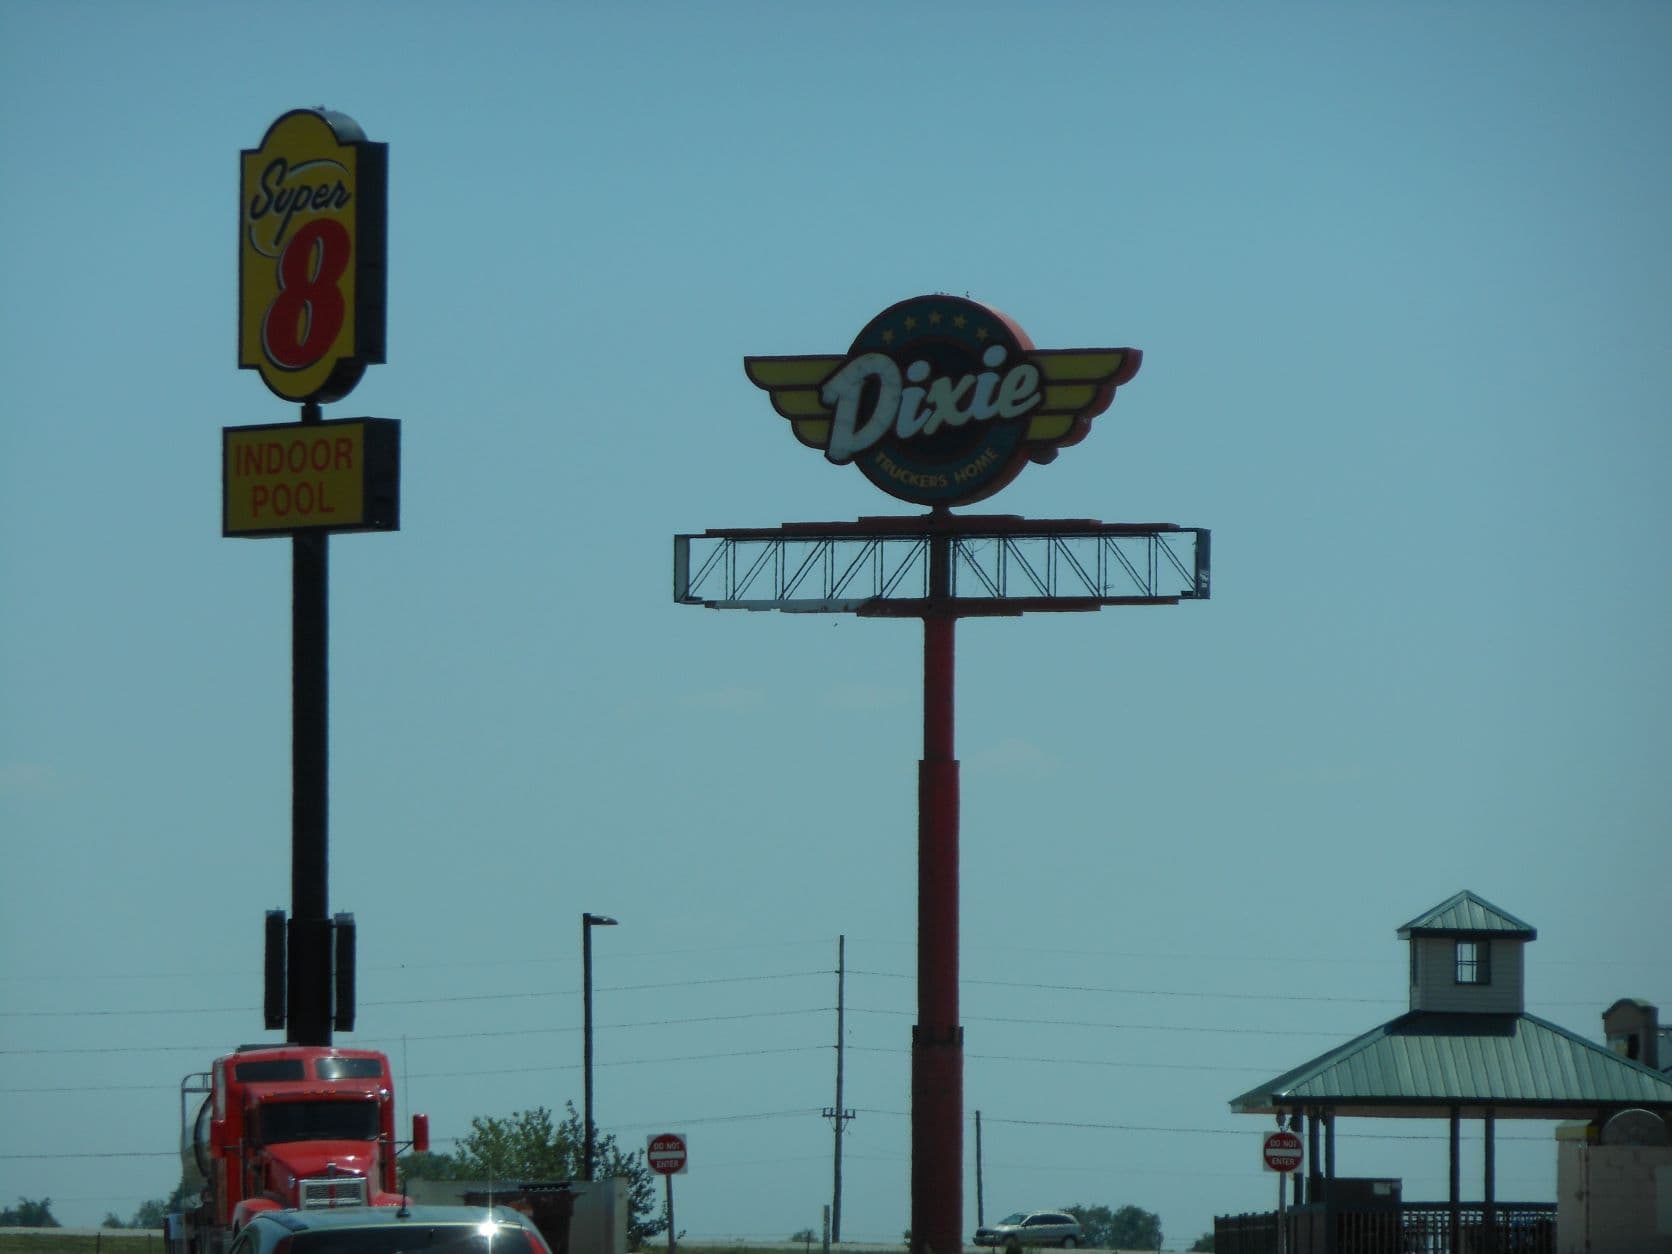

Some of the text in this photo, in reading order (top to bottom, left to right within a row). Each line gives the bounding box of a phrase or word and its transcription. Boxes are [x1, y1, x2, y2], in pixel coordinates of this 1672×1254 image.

[250, 158, 352, 247] Super
[264, 218, 352, 371] 8
[821, 345, 1041, 461] Dixie
[235, 437, 353, 477] INDOOR
[875, 447, 998, 487] TRUCKERS HOME
[251, 481, 334, 517] POOL
[653, 1142, 680, 1150] DO NOT
[1270, 1139, 1297, 1148] DO NOT
[1272, 1157, 1296, 1166] ENTER
[656, 1160, 679, 1168] ENTER
